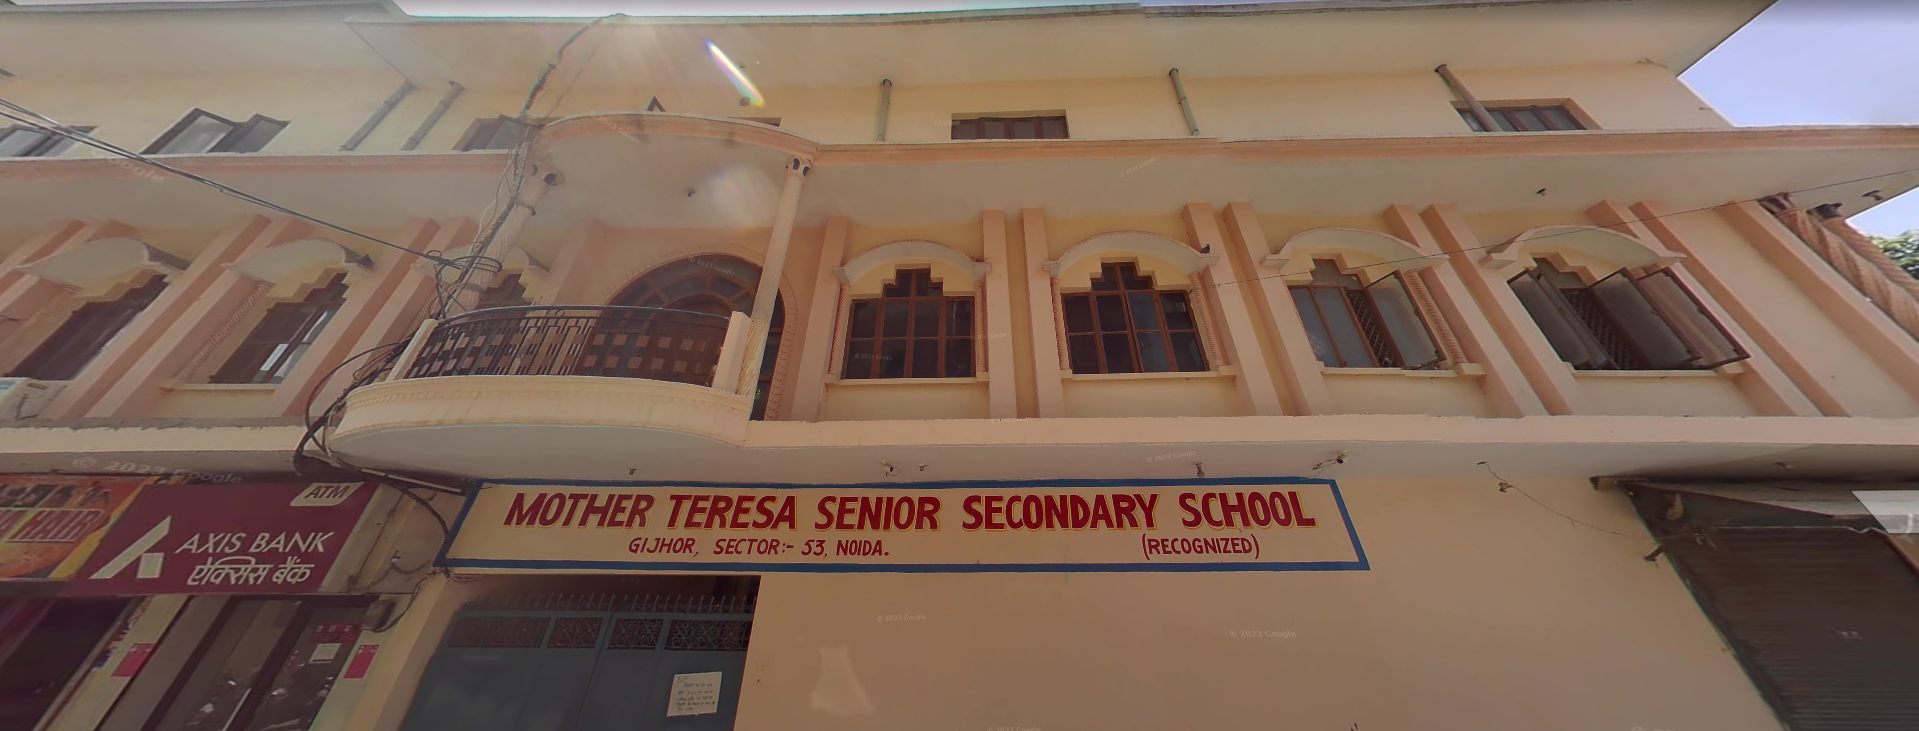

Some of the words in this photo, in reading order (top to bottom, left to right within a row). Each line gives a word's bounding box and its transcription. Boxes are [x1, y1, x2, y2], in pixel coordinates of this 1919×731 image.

[303, 485, 350, 499] ATM
[502, 492, 656, 530] MOTHER
[666, 494, 798, 531] TERESA
[814, 495, 941, 532] SENIOR
[961, 493, 1159, 532] SECONDARY
[1178, 490, 1318, 530] SCHOOL
[175, 532, 247, 553] AXIS
[248, 531, 335, 553] BANK
[628, 536, 700, 558] GIJHOR,
[800, 538, 828, 559] 53,
[835, 539, 890, 557] NOIDA.
[1141, 532, 1260, 561] (RECOGNIZED)
[186, 555, 274, 585] ऐक्सिस
[271, 555, 316, 584] बैंक
